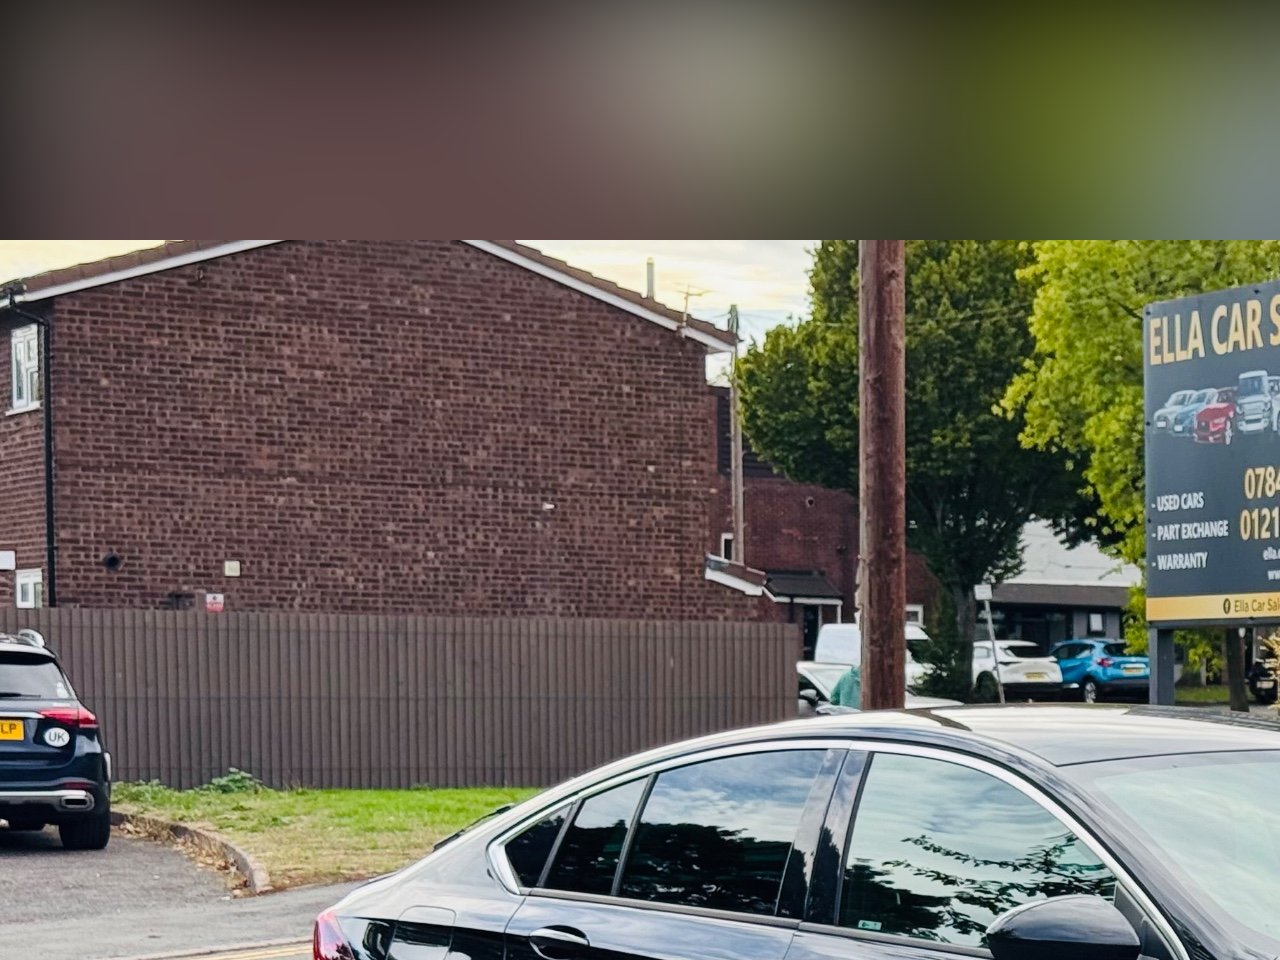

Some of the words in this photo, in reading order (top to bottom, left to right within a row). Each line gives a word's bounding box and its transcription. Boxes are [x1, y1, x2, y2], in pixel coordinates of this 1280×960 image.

[1150, 310, 1205, 365] ELLA
[1211, 299, 1263, 355] CAR
[1157, 494, 1179, 511] USED
[1181, 492, 1204, 509] CARS
[1157, 524, 1180, 541] PART
[1181, 520, 1228, 539] EXCHANGE
[1240, 507, 1279, 540] 0121
[1157, 552, 1208, 570] WARRANTY
[1234, 599, 1249, 612] Ella
[1252, 599, 1265, 612] Car
[49, 732, 66, 742] UK
